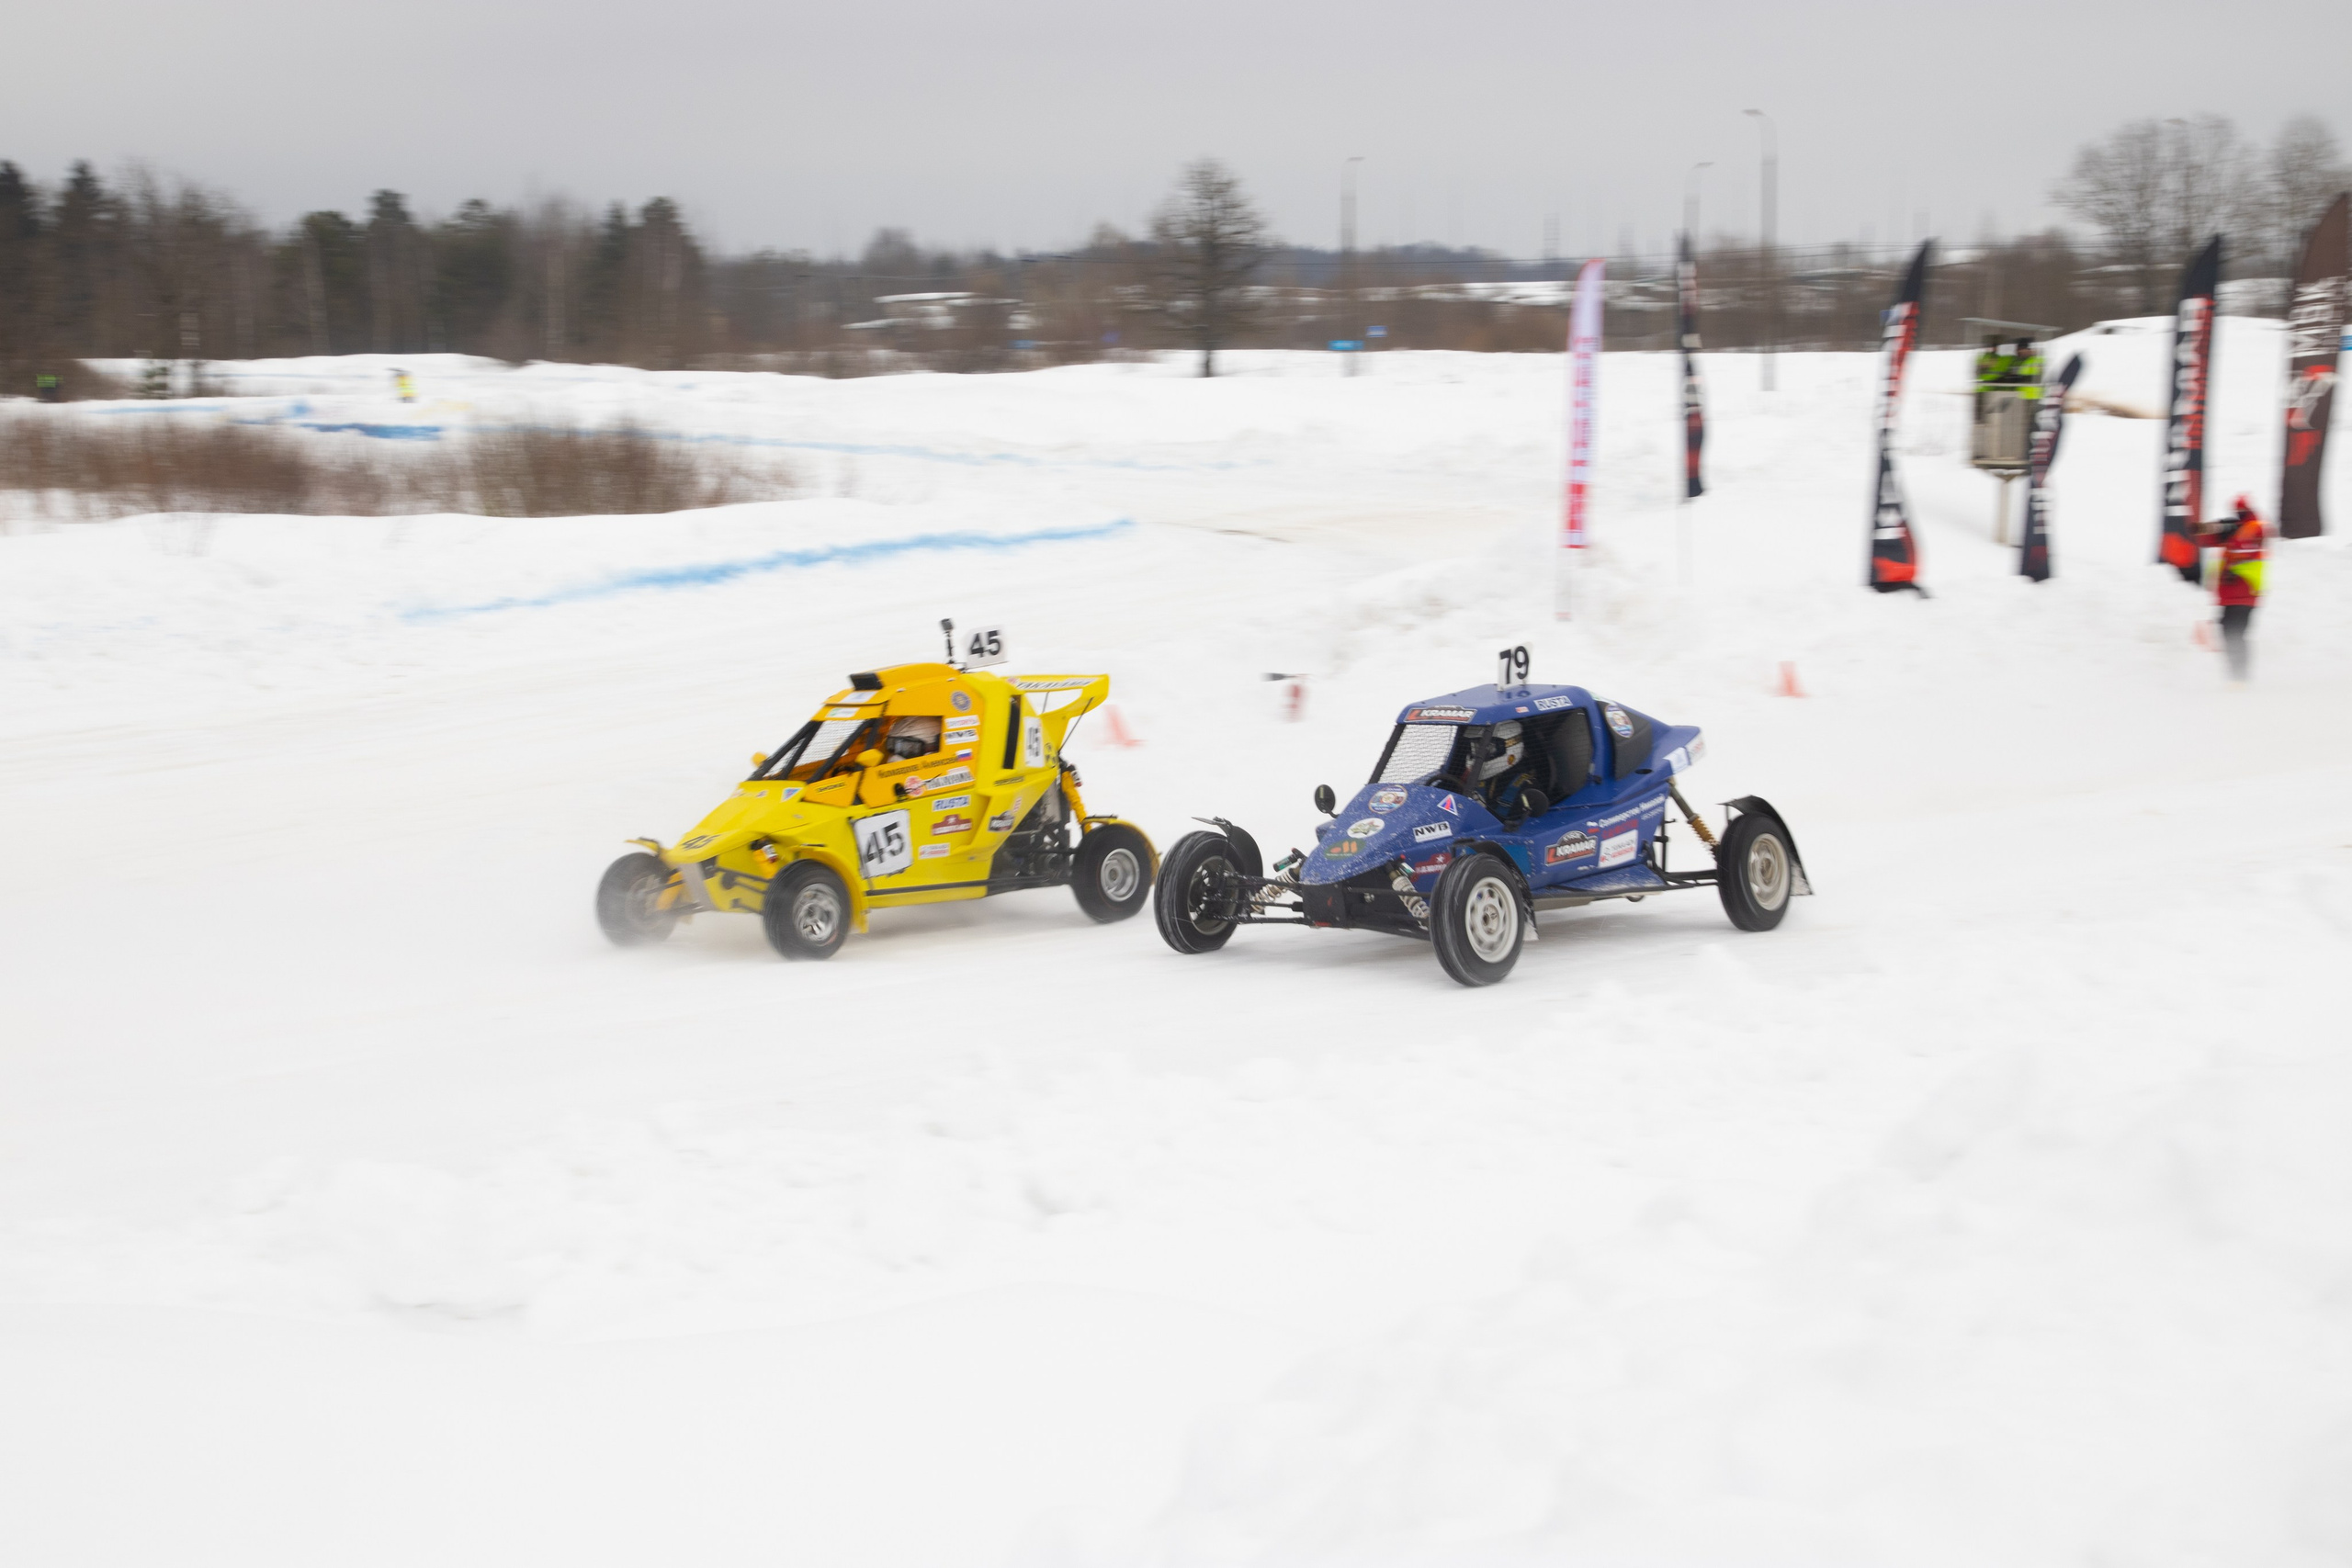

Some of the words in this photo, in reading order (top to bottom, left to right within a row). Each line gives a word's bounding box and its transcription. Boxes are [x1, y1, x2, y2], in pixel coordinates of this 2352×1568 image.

[969, 629, 1001, 658] 45
[1499, 645, 1529, 684] 79
[1535, 695, 1572, 710] RUSTA
[1420, 708, 1473, 720] KRAMAR
[933, 795, 970, 811] RUSTA
[1414, 822, 1449, 837] NWB
[681, 833, 722, 852] 45
[864, 820, 906, 865] 45
[1555, 839, 1597, 857] KRAMAR
